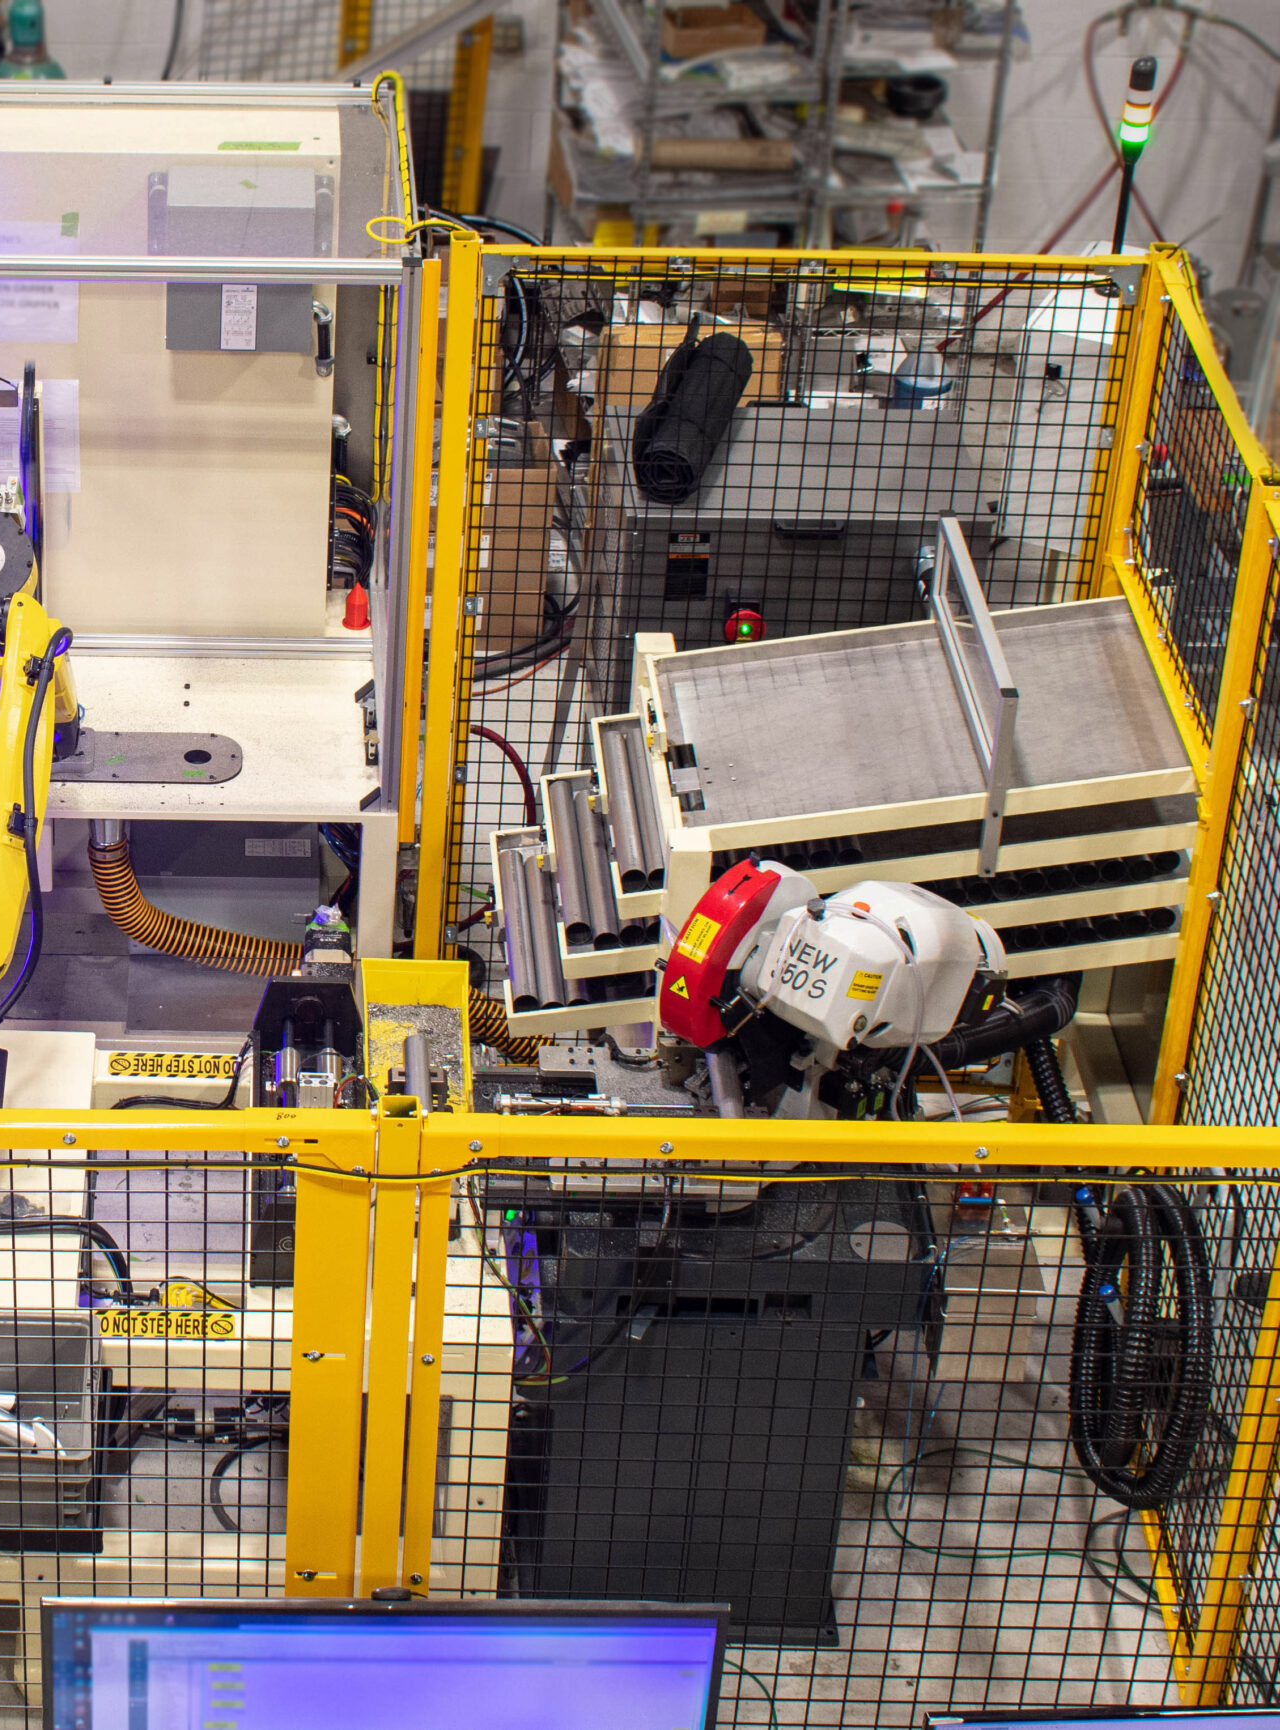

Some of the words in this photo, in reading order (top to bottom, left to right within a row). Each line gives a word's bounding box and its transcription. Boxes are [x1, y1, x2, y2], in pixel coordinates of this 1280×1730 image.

[771, 958, 810, 991] 50
[133, 1057, 163, 1073] HERE
[166, 1058, 195, 1074] STEP
[197, 1059, 220, 1074] NOT
[112, 1317, 138, 1334] NOT
[140, 1318, 173, 1335] STEP
[175, 1318, 209, 1336] HERE
